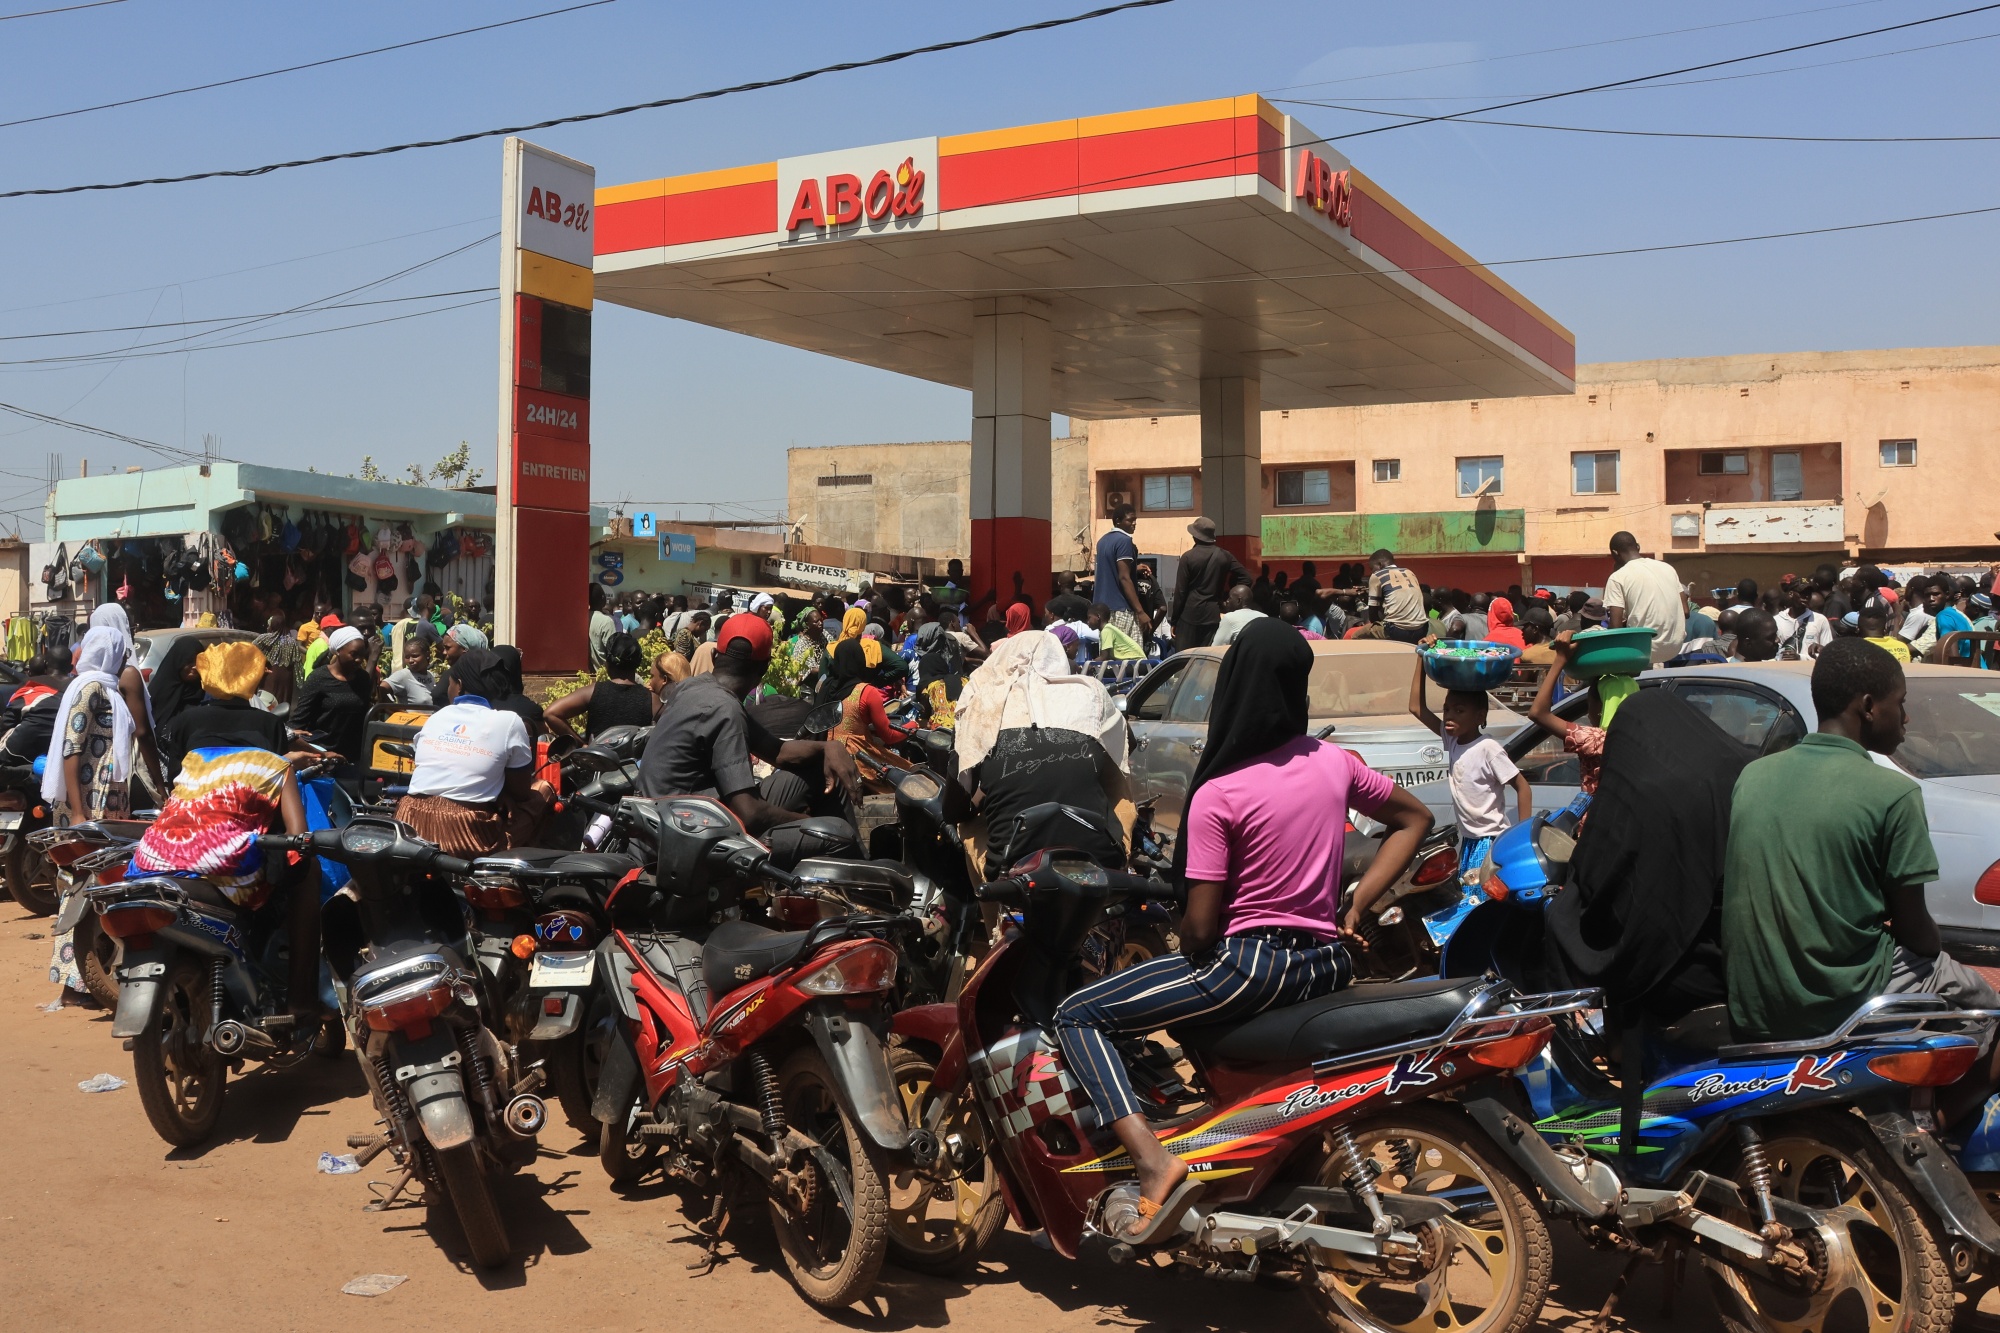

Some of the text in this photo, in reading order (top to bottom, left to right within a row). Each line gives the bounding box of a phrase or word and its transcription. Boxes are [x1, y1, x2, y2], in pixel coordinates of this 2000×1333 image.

[526, 403, 578, 430] 24H/24
[522, 461, 587, 483] ENTRETIEN
[672, 543, 691, 553] wave
[764, 557, 793, 571] CAFE
[796, 562, 847, 579] EXPRESS
[438, 736, 474, 746] CABINET
[473, 747, 492, 757] PUBLIC
[734, 966, 751, 976] TVS
[729, 992, 766, 1030] NEO NX
[1187, 1162, 1212, 1173] KTM
